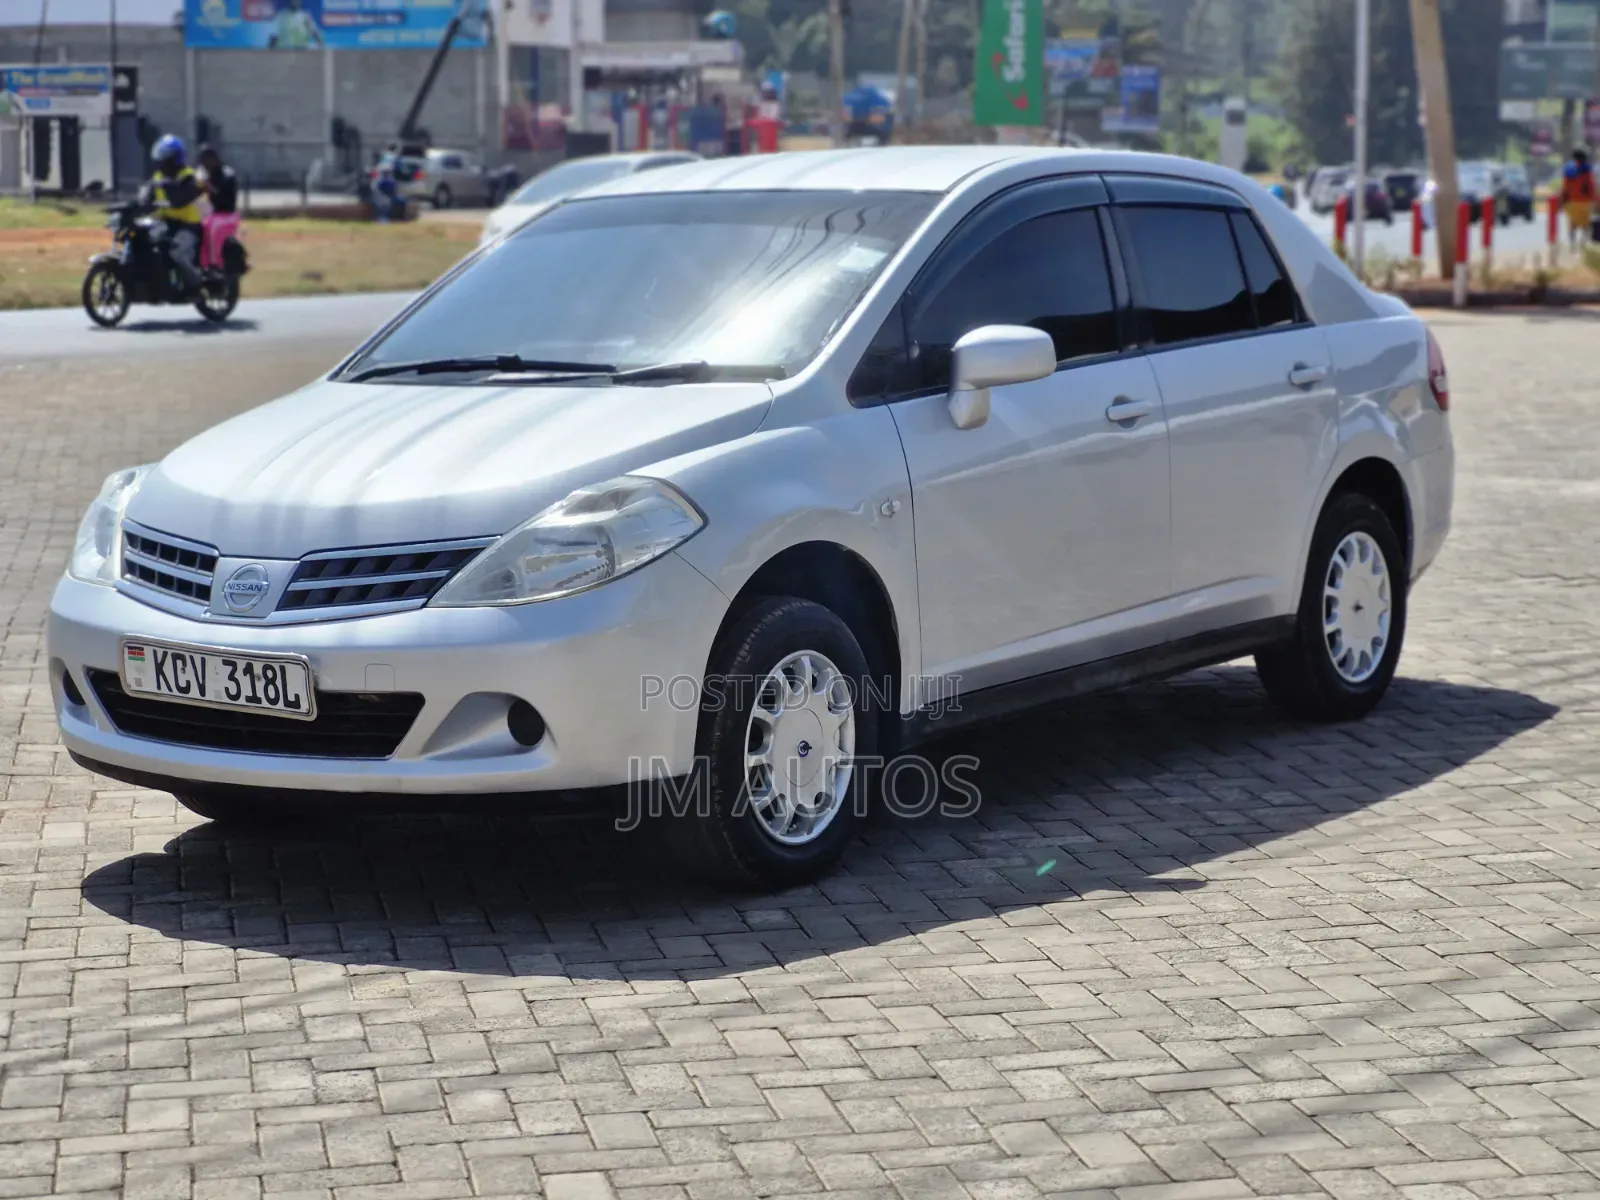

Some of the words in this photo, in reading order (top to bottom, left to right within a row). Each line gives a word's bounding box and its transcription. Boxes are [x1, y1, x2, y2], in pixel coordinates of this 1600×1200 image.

[227, 583, 263, 592] NISSAN
[153, 649, 206, 697] KCV
[222, 659, 301, 709] 318L
